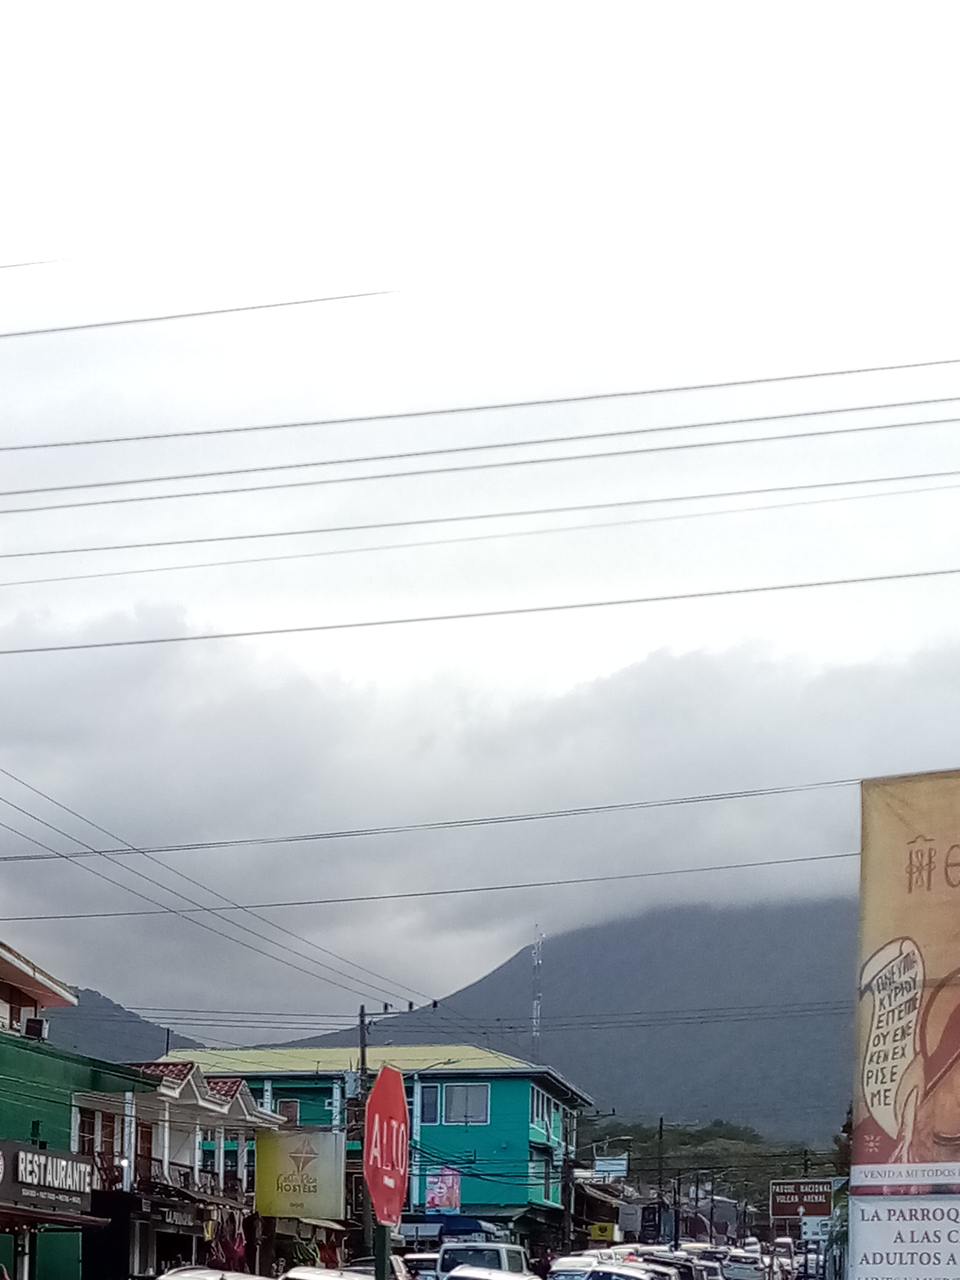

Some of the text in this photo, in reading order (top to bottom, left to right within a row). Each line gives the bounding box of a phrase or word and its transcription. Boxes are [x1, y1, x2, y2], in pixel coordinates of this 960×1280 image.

[369, 1113, 406, 1175] ALTO
[18, 1151, 91, 1193] RESTAURANTE
[921, 1168, 956, 1178] TODOS
[277, 1183, 318, 1193] HOSTELS
[860, 1208, 960, 1223] LA PARROQ
[893, 1229, 960, 1243] A LAS C
[859, 1252, 958, 1266] ADULTOS A
